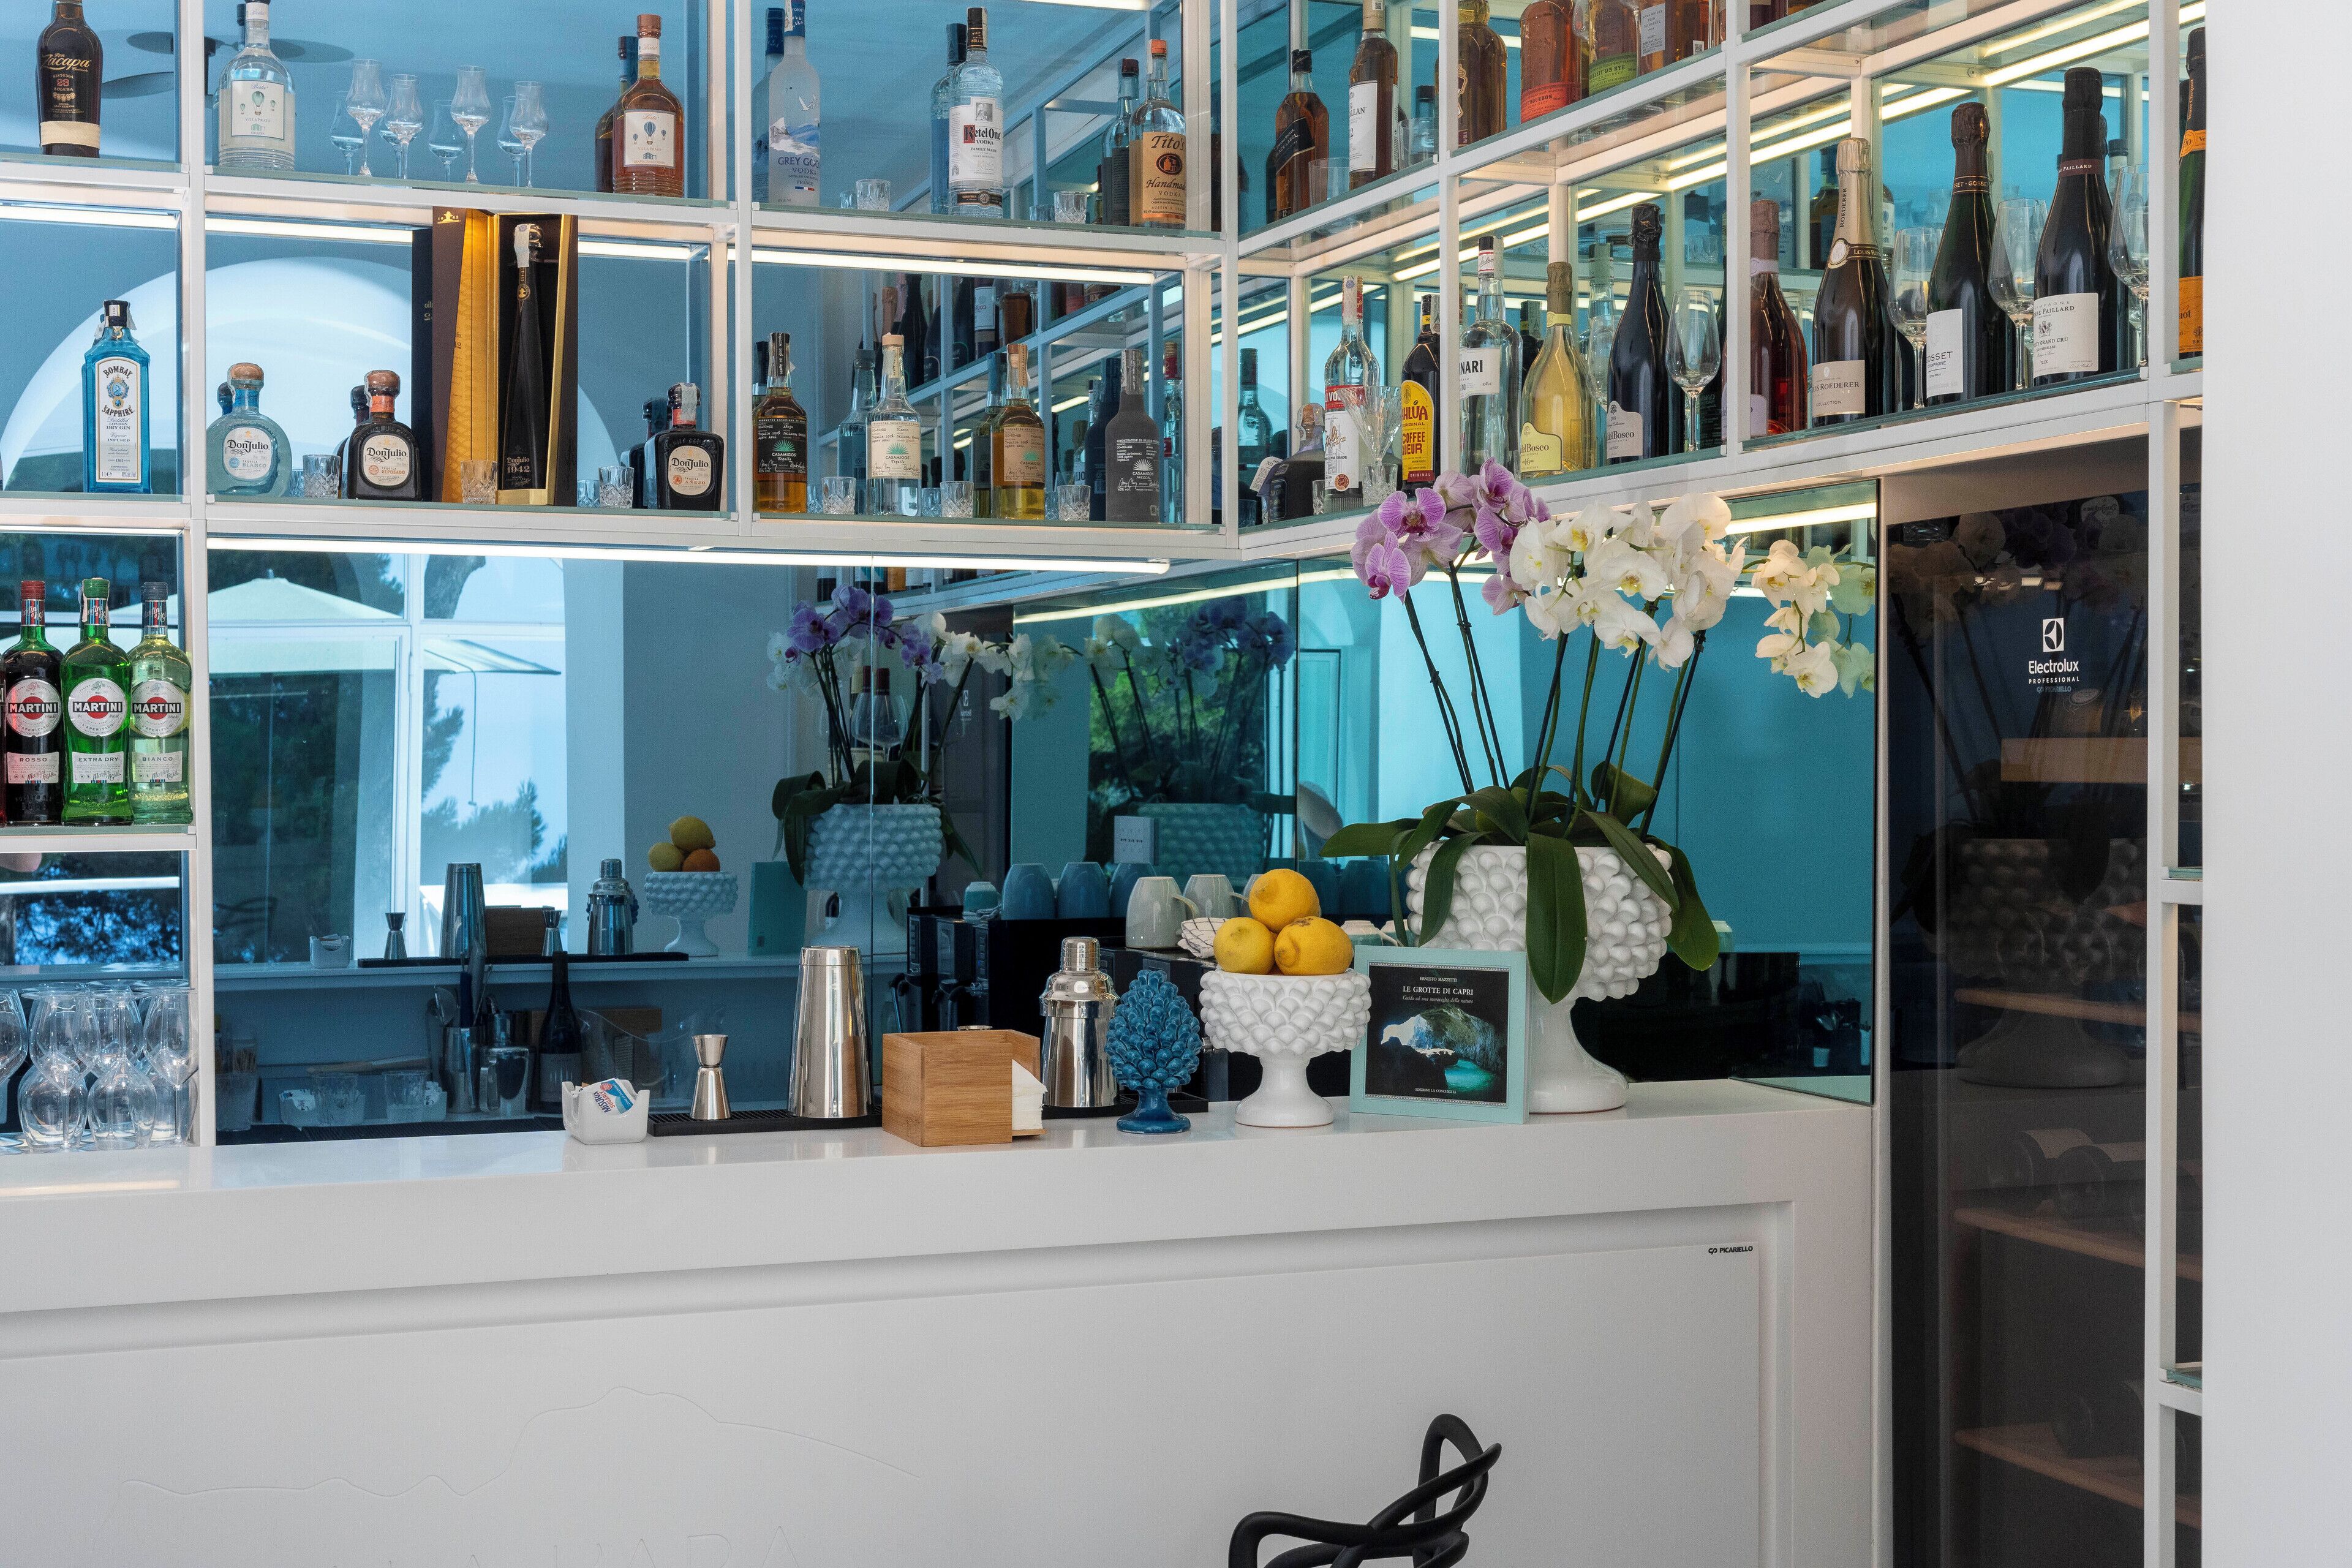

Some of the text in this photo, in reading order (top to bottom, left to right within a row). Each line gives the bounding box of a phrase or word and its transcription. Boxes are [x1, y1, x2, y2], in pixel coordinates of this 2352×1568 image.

[964, 125, 1001, 141] Ketel One
[1151, 134, 1185, 151] Tito's
[778, 156, 801, 165] GREY
[792, 167, 817, 176] VODKA
[1839, 187, 1847, 228] ROEDERER
[2042, 306, 2075, 314] PAILLARD
[103, 366, 133, 379] BOMBAY
[1820, 381, 1860, 391] ROEDERER
[102, 405, 134, 417] SAPPHIRE
[1402, 431, 1425, 444] COFFEE
[2029, 658, 2079, 674] Electrolux
[9, 704, 57, 712] MARTINI
[74, 703, 122, 712] MARTINI
[133, 704, 180, 713] MARTINI
[1413, 986, 1441, 995] GROTTE
[1453, 987, 1474, 996] CAPRI
[594, 1091, 612, 1113] MISURA
[600, 1091, 616, 1109] SUGARLY
[1719, 1245, 1753, 1254] PICARIELLO
